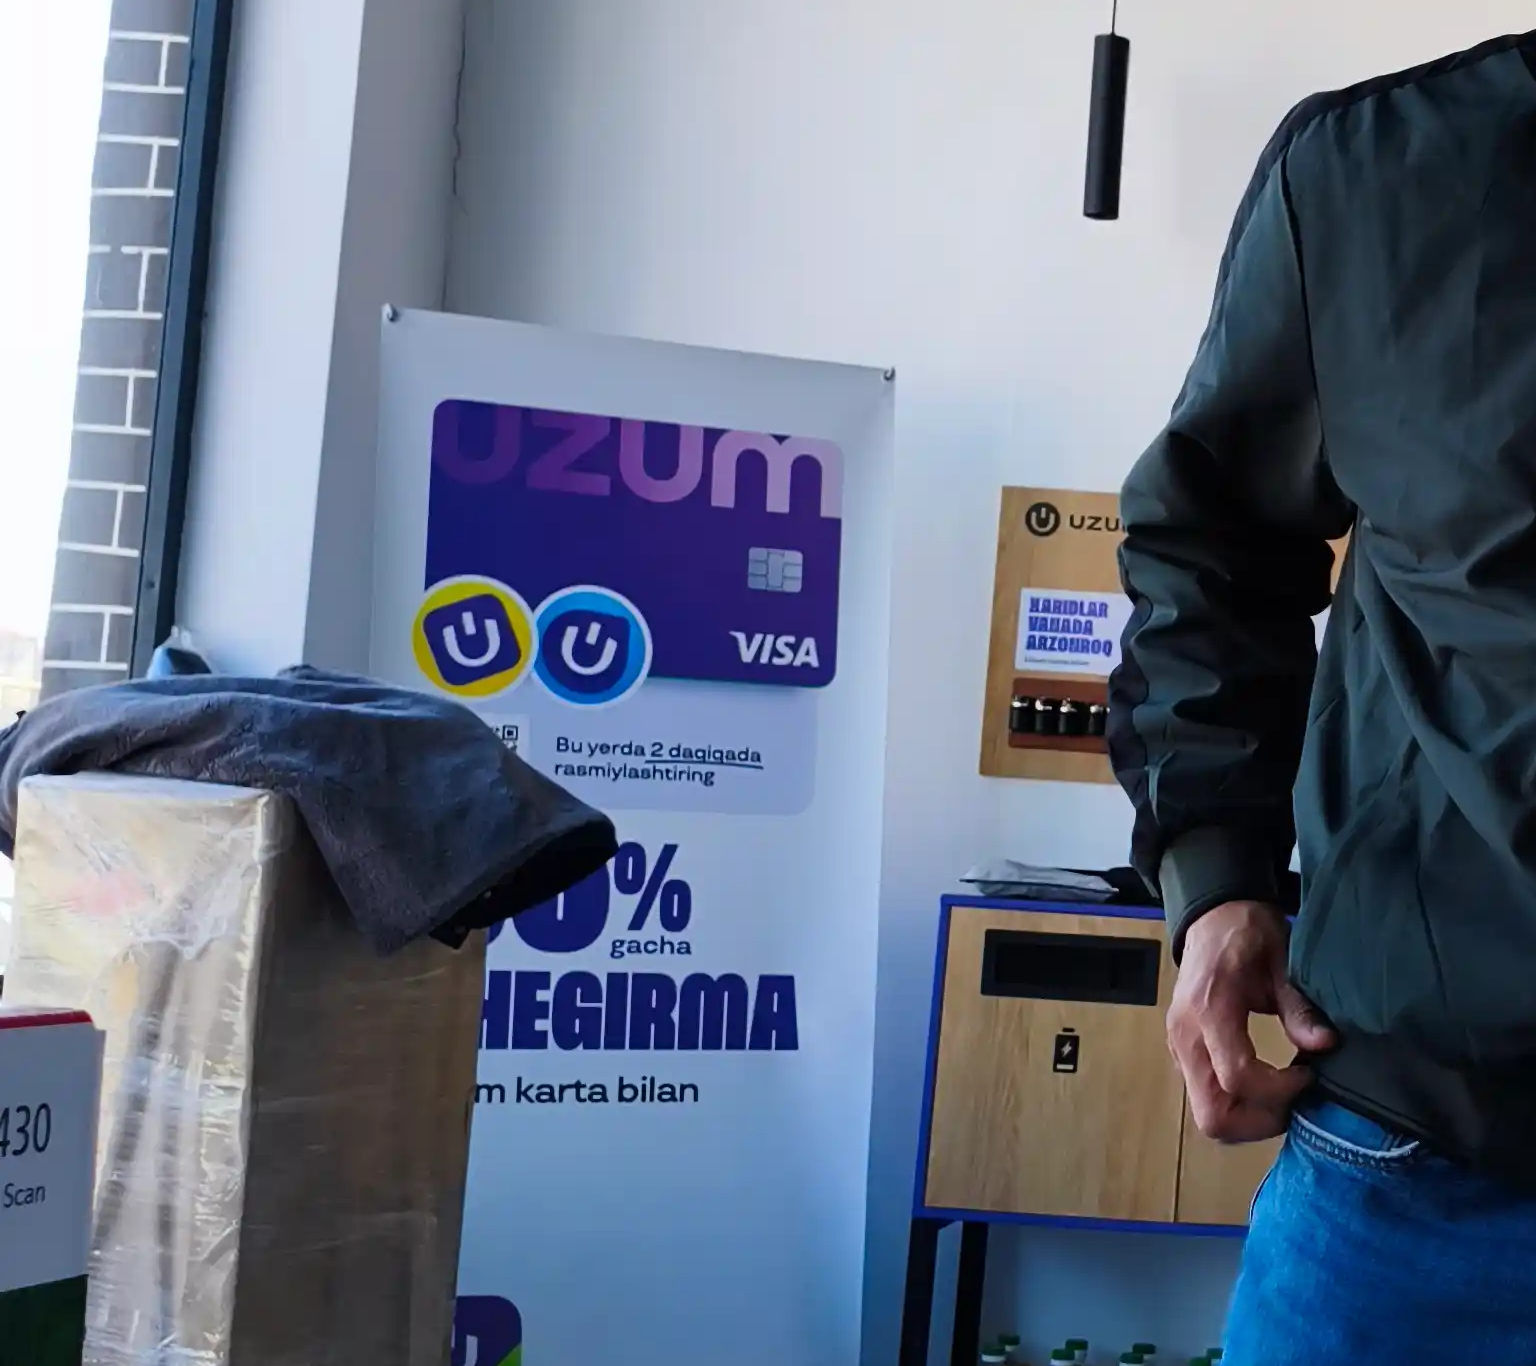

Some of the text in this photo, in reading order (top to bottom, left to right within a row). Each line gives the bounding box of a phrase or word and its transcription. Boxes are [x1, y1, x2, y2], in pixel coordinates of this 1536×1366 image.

[729, 631, 820, 668] VISA
[1025, 634, 1113, 657] ARZONROQ
[555, 737, 762, 763] Bu yerda 2 daqiqada
[554, 761, 715, 787] rasmiylashtiring
[486, 841, 693, 953] 0%
[610, 935, 692, 959] gacha
[478, 970, 800, 1052] HEGIRMA
[515, 1076, 609, 1104] karta
[618, 1075, 700, 1104] bilan
[3, 1181, 46, 1208] Scan
